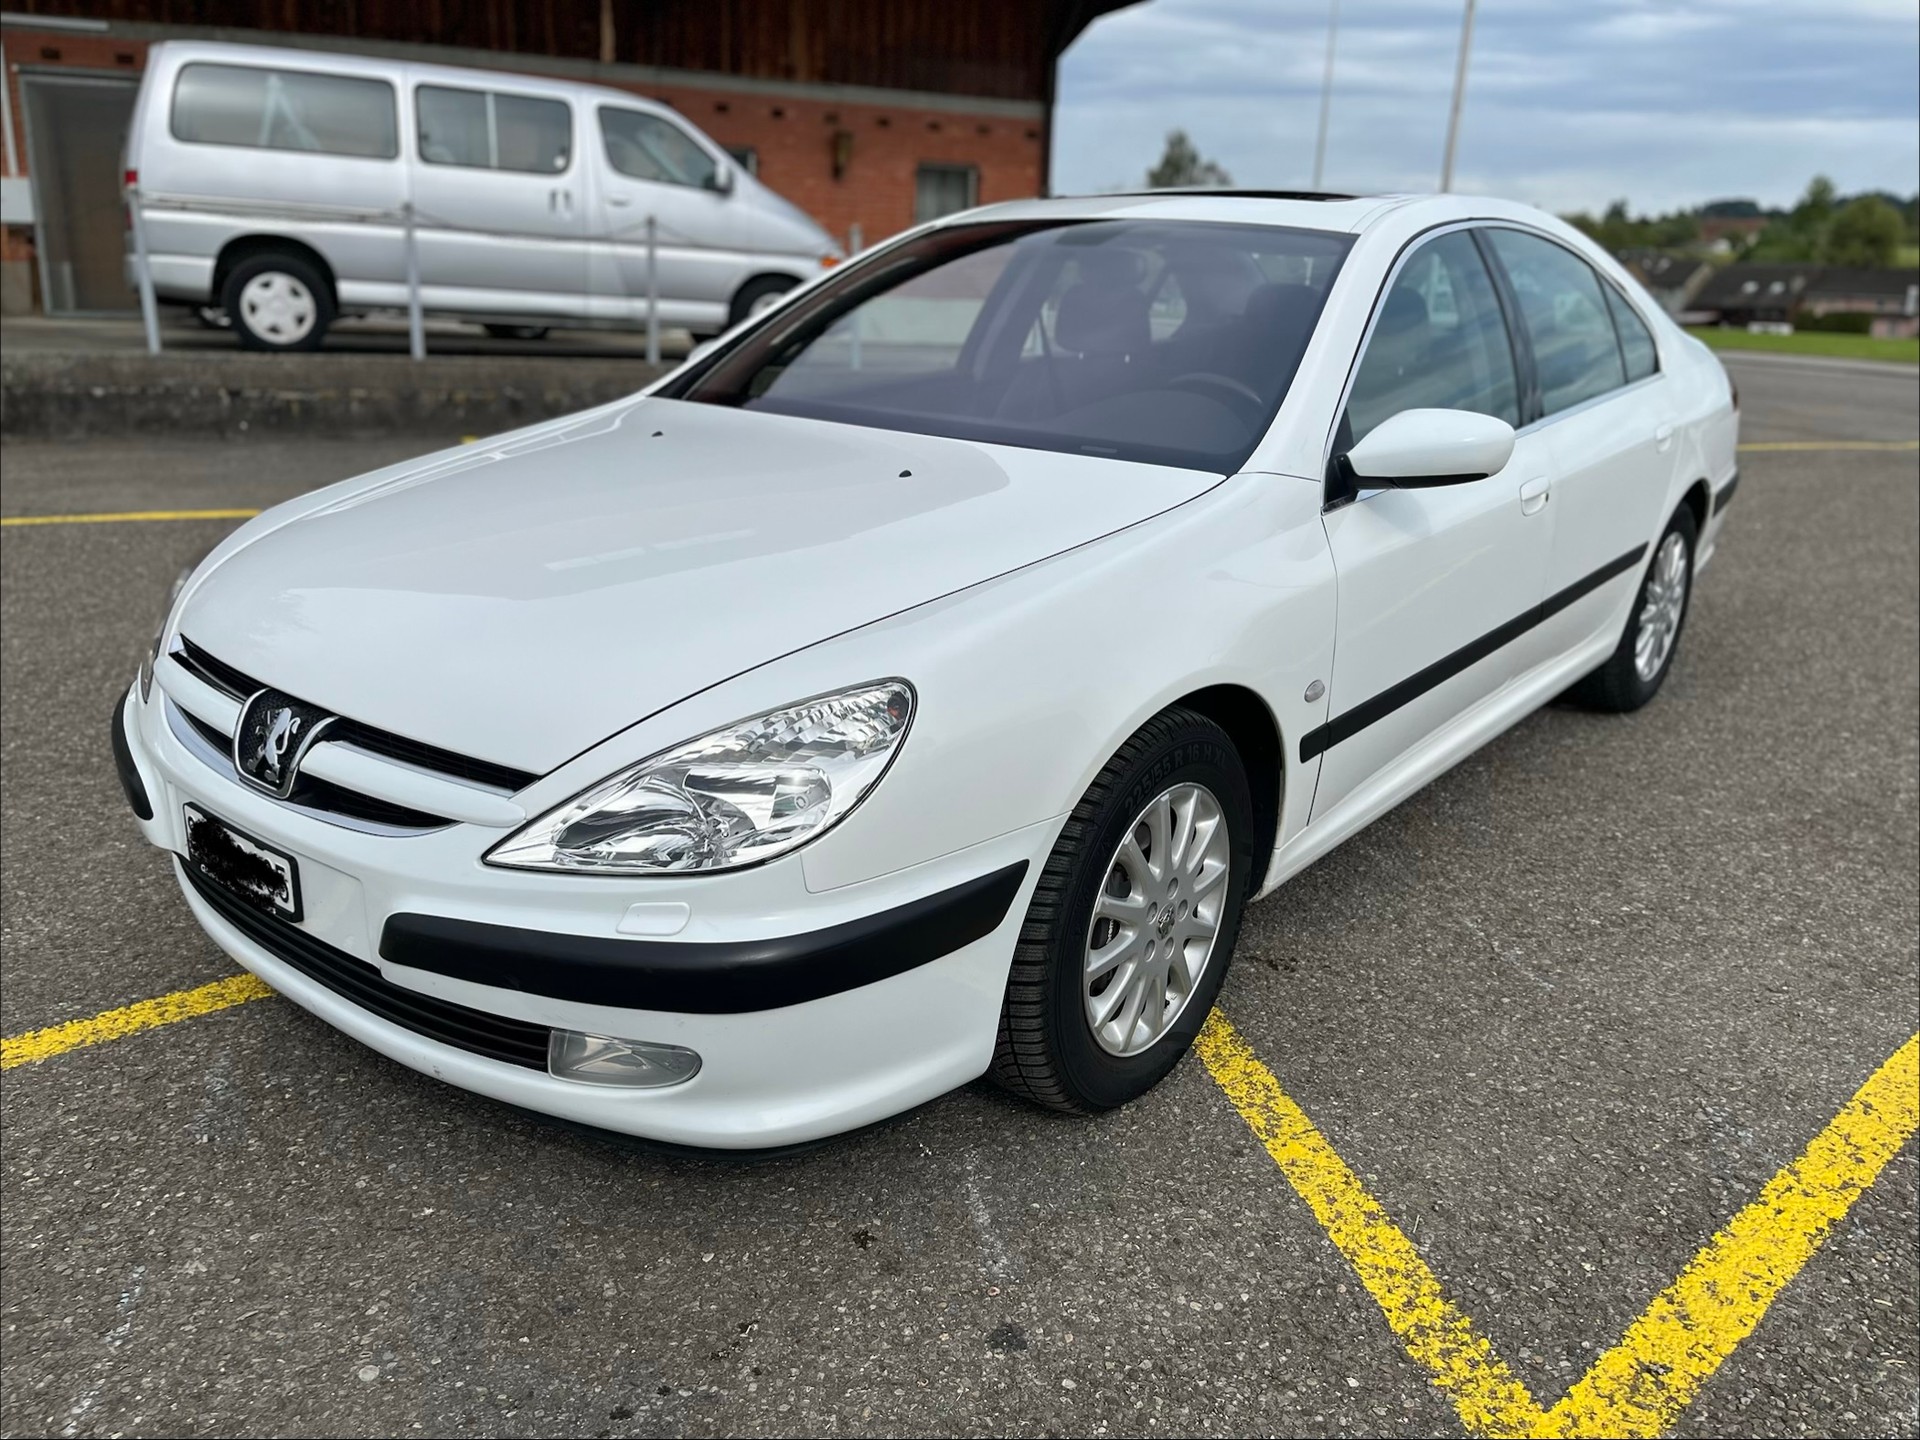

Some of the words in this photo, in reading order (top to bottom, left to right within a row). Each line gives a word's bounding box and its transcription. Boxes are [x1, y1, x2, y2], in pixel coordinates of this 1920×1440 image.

[1124, 756, 1172, 815] 225/55
[1174, 749, 1184, 768] R
[1187, 744, 1200, 761] 16
